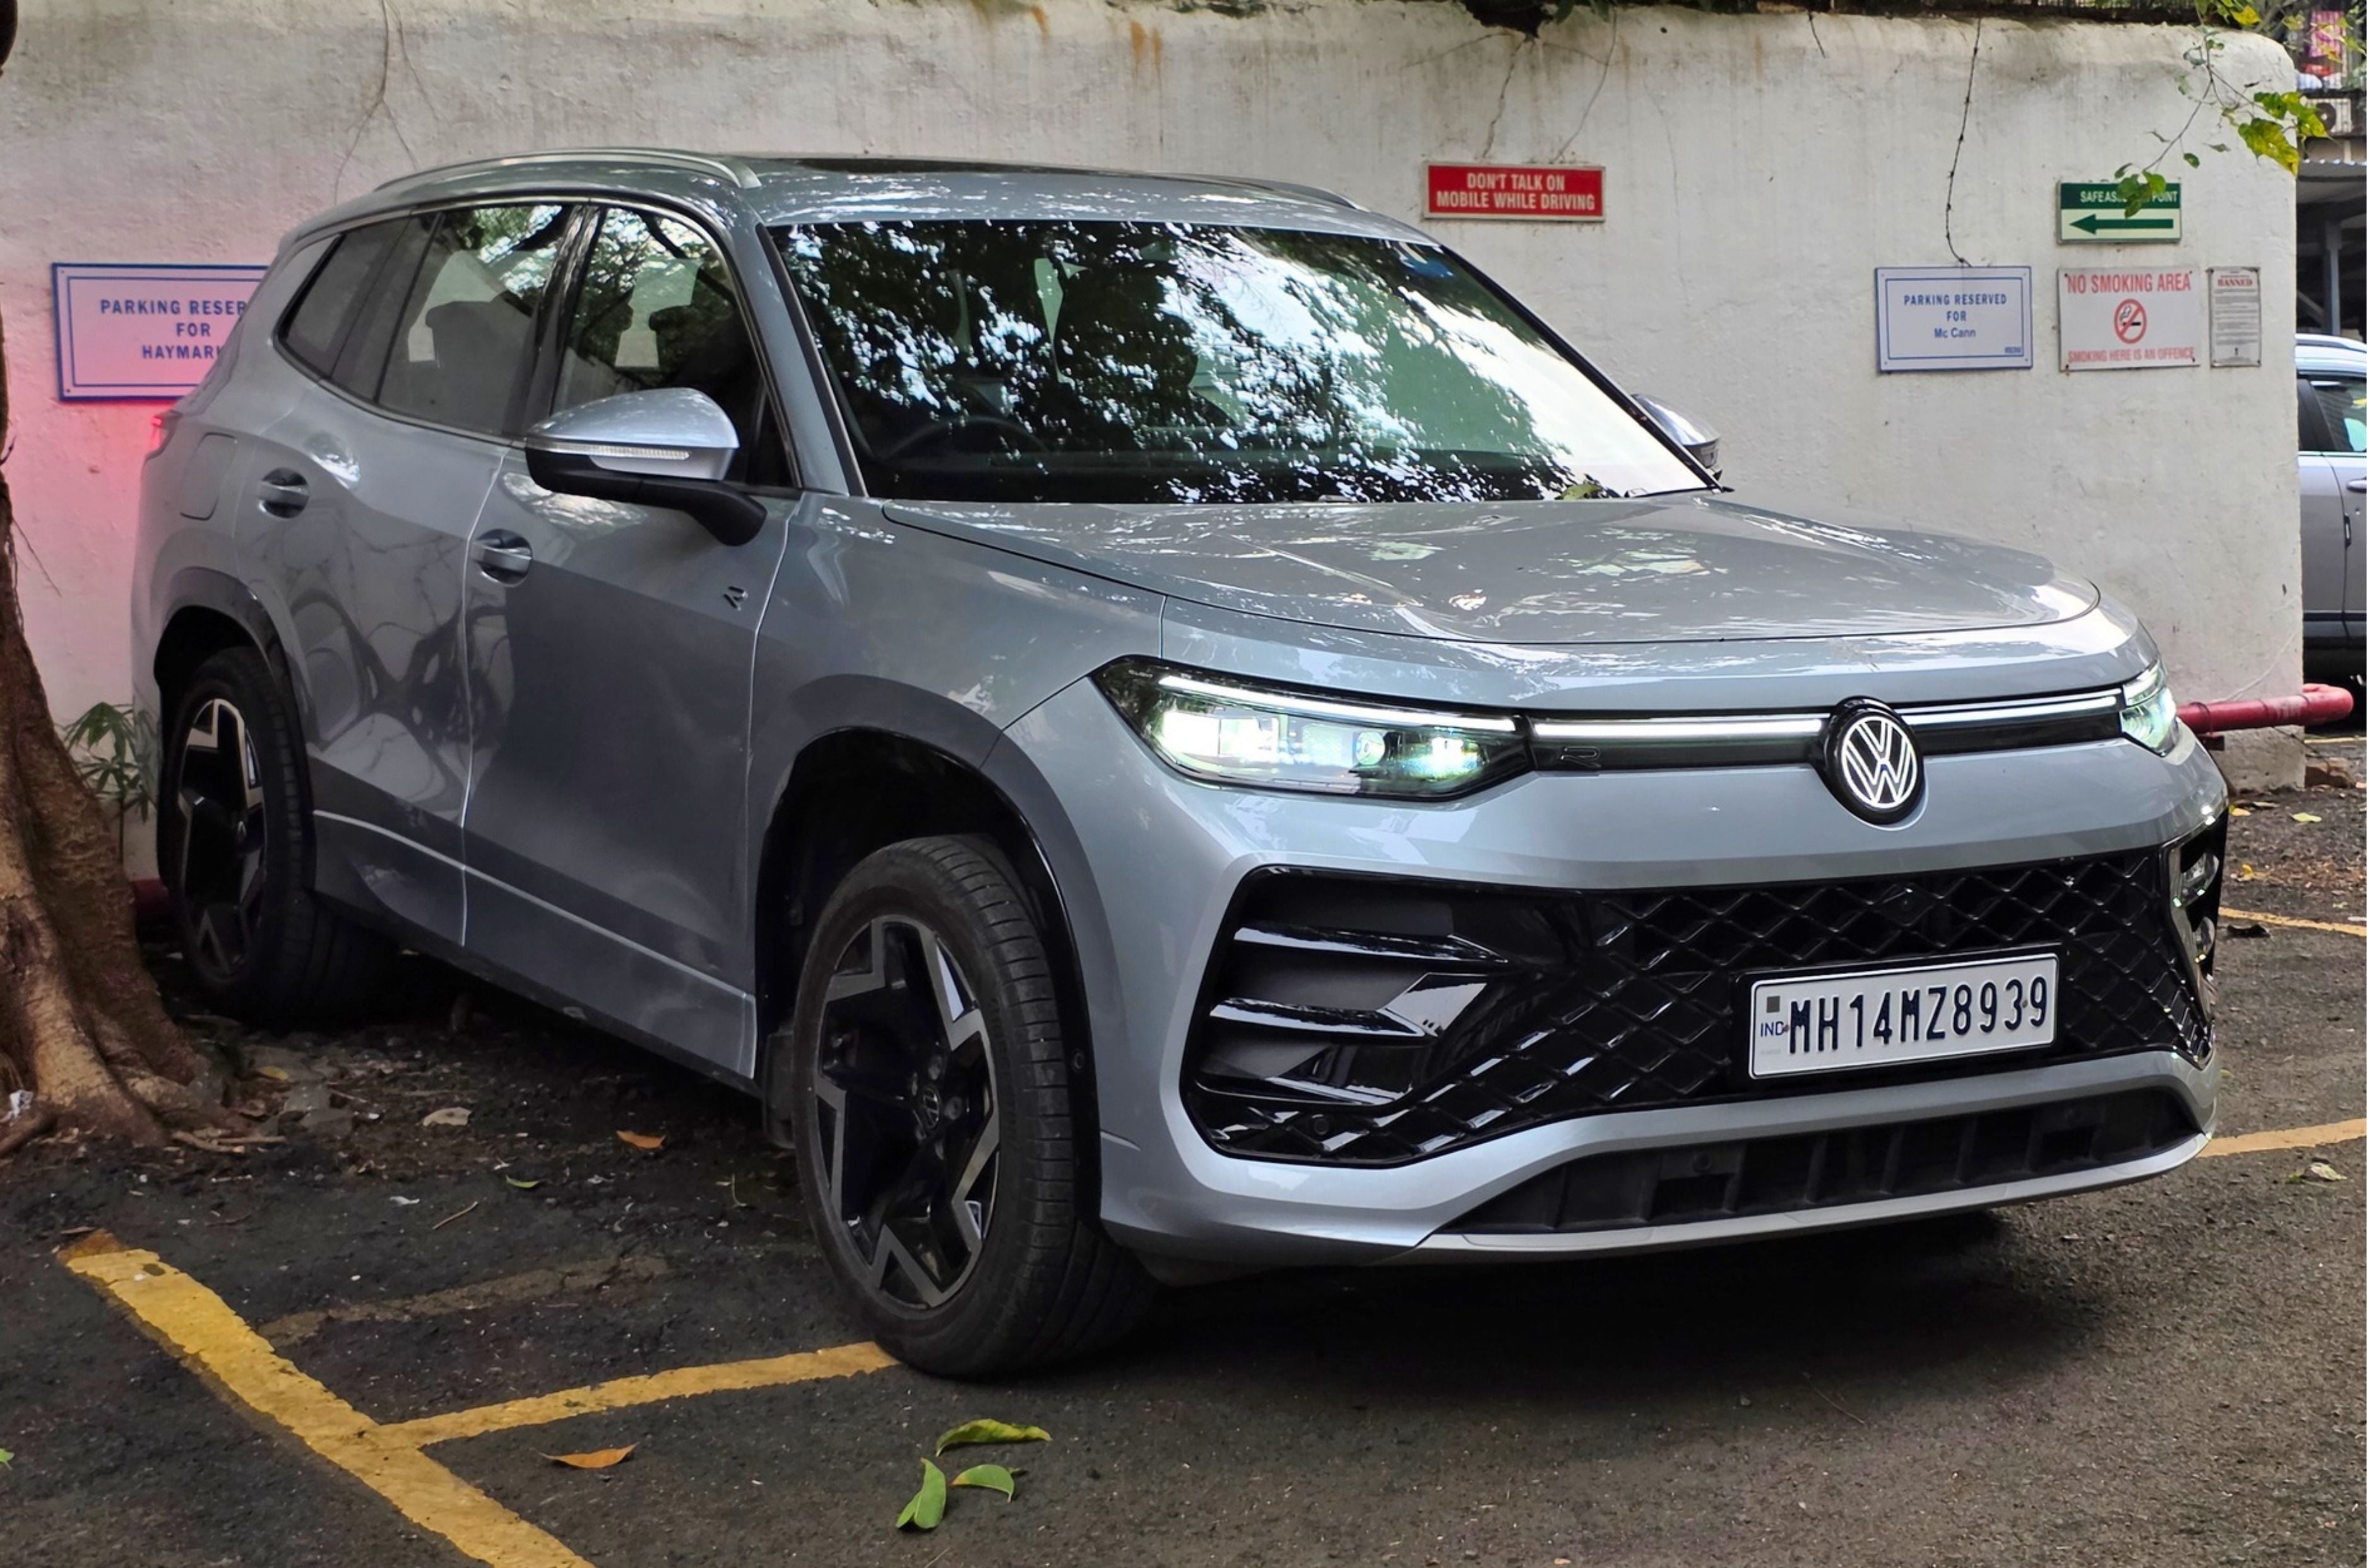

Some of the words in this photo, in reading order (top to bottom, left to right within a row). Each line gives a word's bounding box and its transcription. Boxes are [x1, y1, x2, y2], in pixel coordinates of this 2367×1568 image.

[1467, 172, 1506, 189] DON'T
[1510, 174, 1542, 191] TALK
[1548, 175, 1565, 191] ON
[1436, 191, 1490, 208] MOBILE
[1493, 192, 1536, 209] WHILE
[1541, 193, 1595, 210] DRIVING
[2067, 275, 2086, 294] NO
[2091, 273, 2152, 294] SMOKING
[2157, 273, 2192, 292] AREA
[2217, 278, 2253, 287] BANNED
[100, 299, 181, 314] PARKING
[1904, 295, 1950, 306] PARKING
[1954, 294, 2007, 305] RESERVED
[1946, 311, 1967, 322] FOR
[175, 323, 211, 337] FOR
[1934, 328, 1949, 338] Mc
[1951, 327, 1976, 338] Cann
[2068, 350, 2107, 362] SMOKING
[2109, 349, 2131, 361] HERE
[2133, 348, 2142, 360] IS
[2144, 348, 2156, 360] AN
[2157, 347, 2194, 359] OFFENCE
[1760, 1021, 1784, 1037] IND
